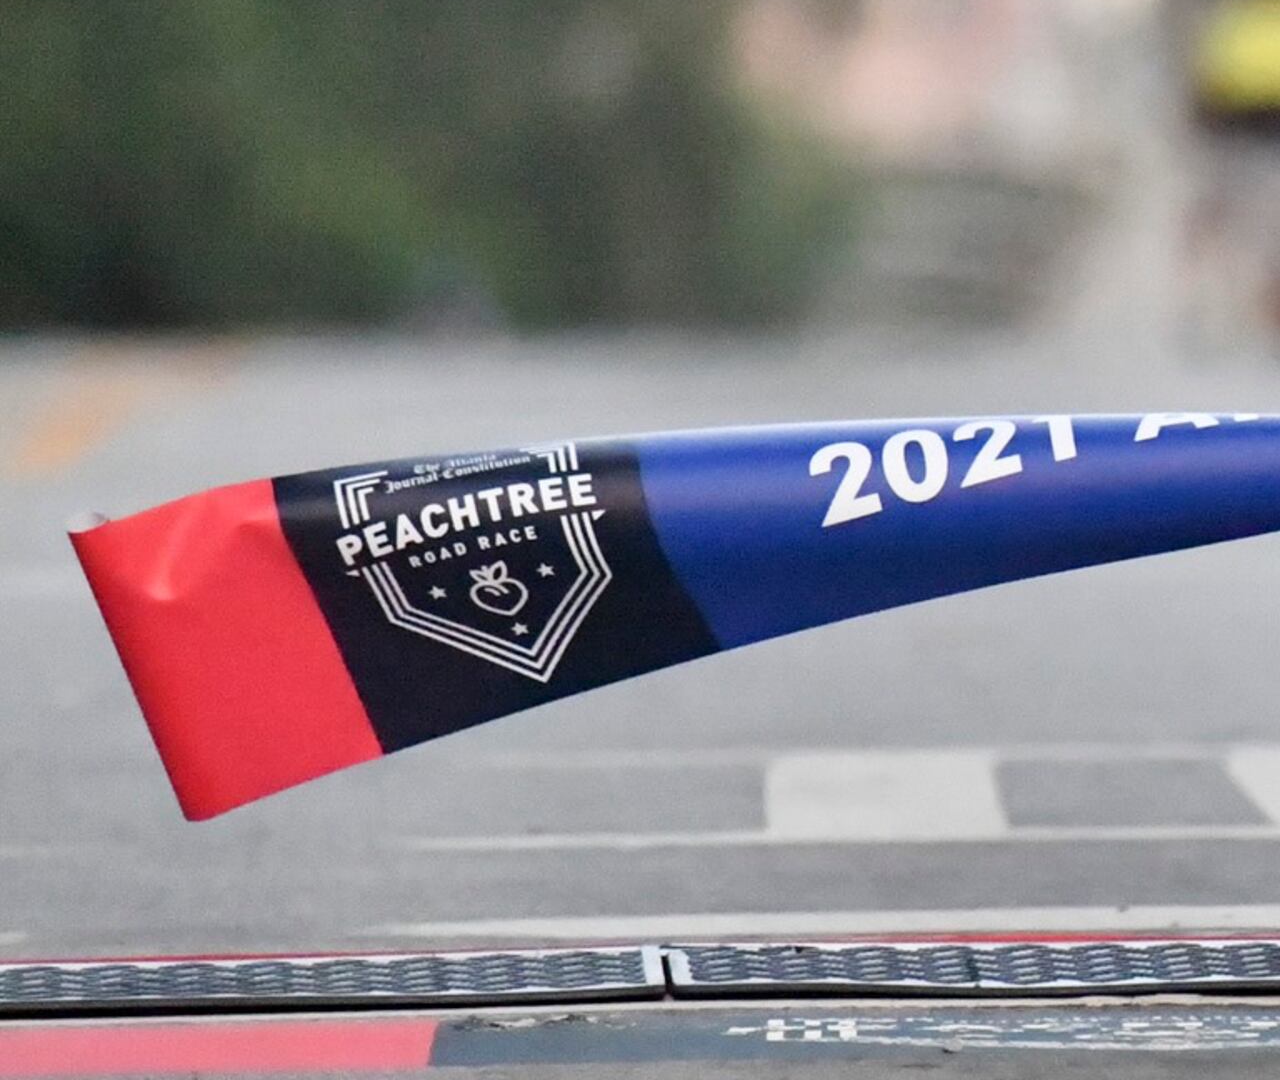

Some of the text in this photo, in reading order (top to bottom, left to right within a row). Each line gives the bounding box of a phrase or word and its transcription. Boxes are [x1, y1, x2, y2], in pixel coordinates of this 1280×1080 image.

[809, 414, 1078, 528] 2021
[335, 473, 598, 566] PEACHTREE
[408, 525, 538, 569] ROAD RACE
